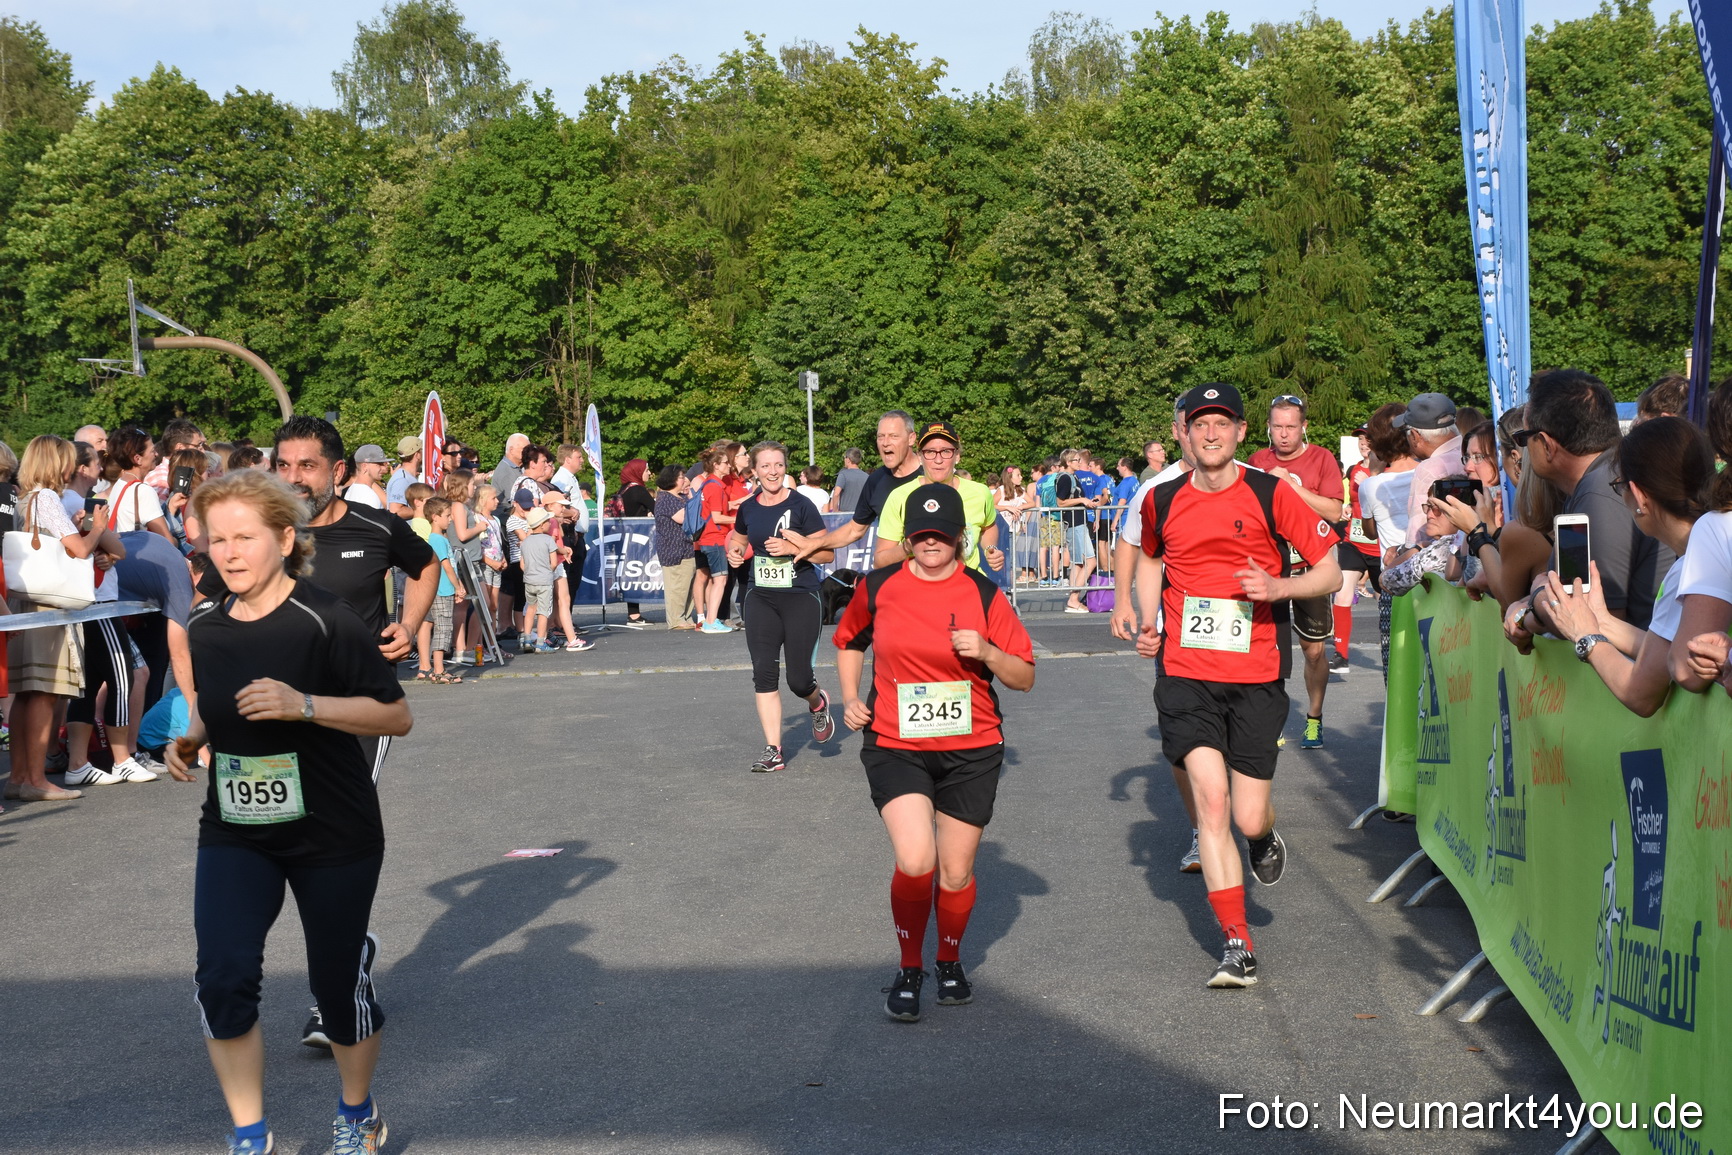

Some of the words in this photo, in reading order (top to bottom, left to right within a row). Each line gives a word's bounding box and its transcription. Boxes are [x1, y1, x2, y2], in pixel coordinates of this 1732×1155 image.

[1233, 519, 1243, 533] 9
[341, 550, 365, 559] MEHMET
[758, 567, 785, 579] 1931
[907, 700, 963, 722] 2345
[226, 779, 288, 805] 1959
[254, 805, 282, 813] Gudrun
[1636, 805, 1663, 836] Fischer
